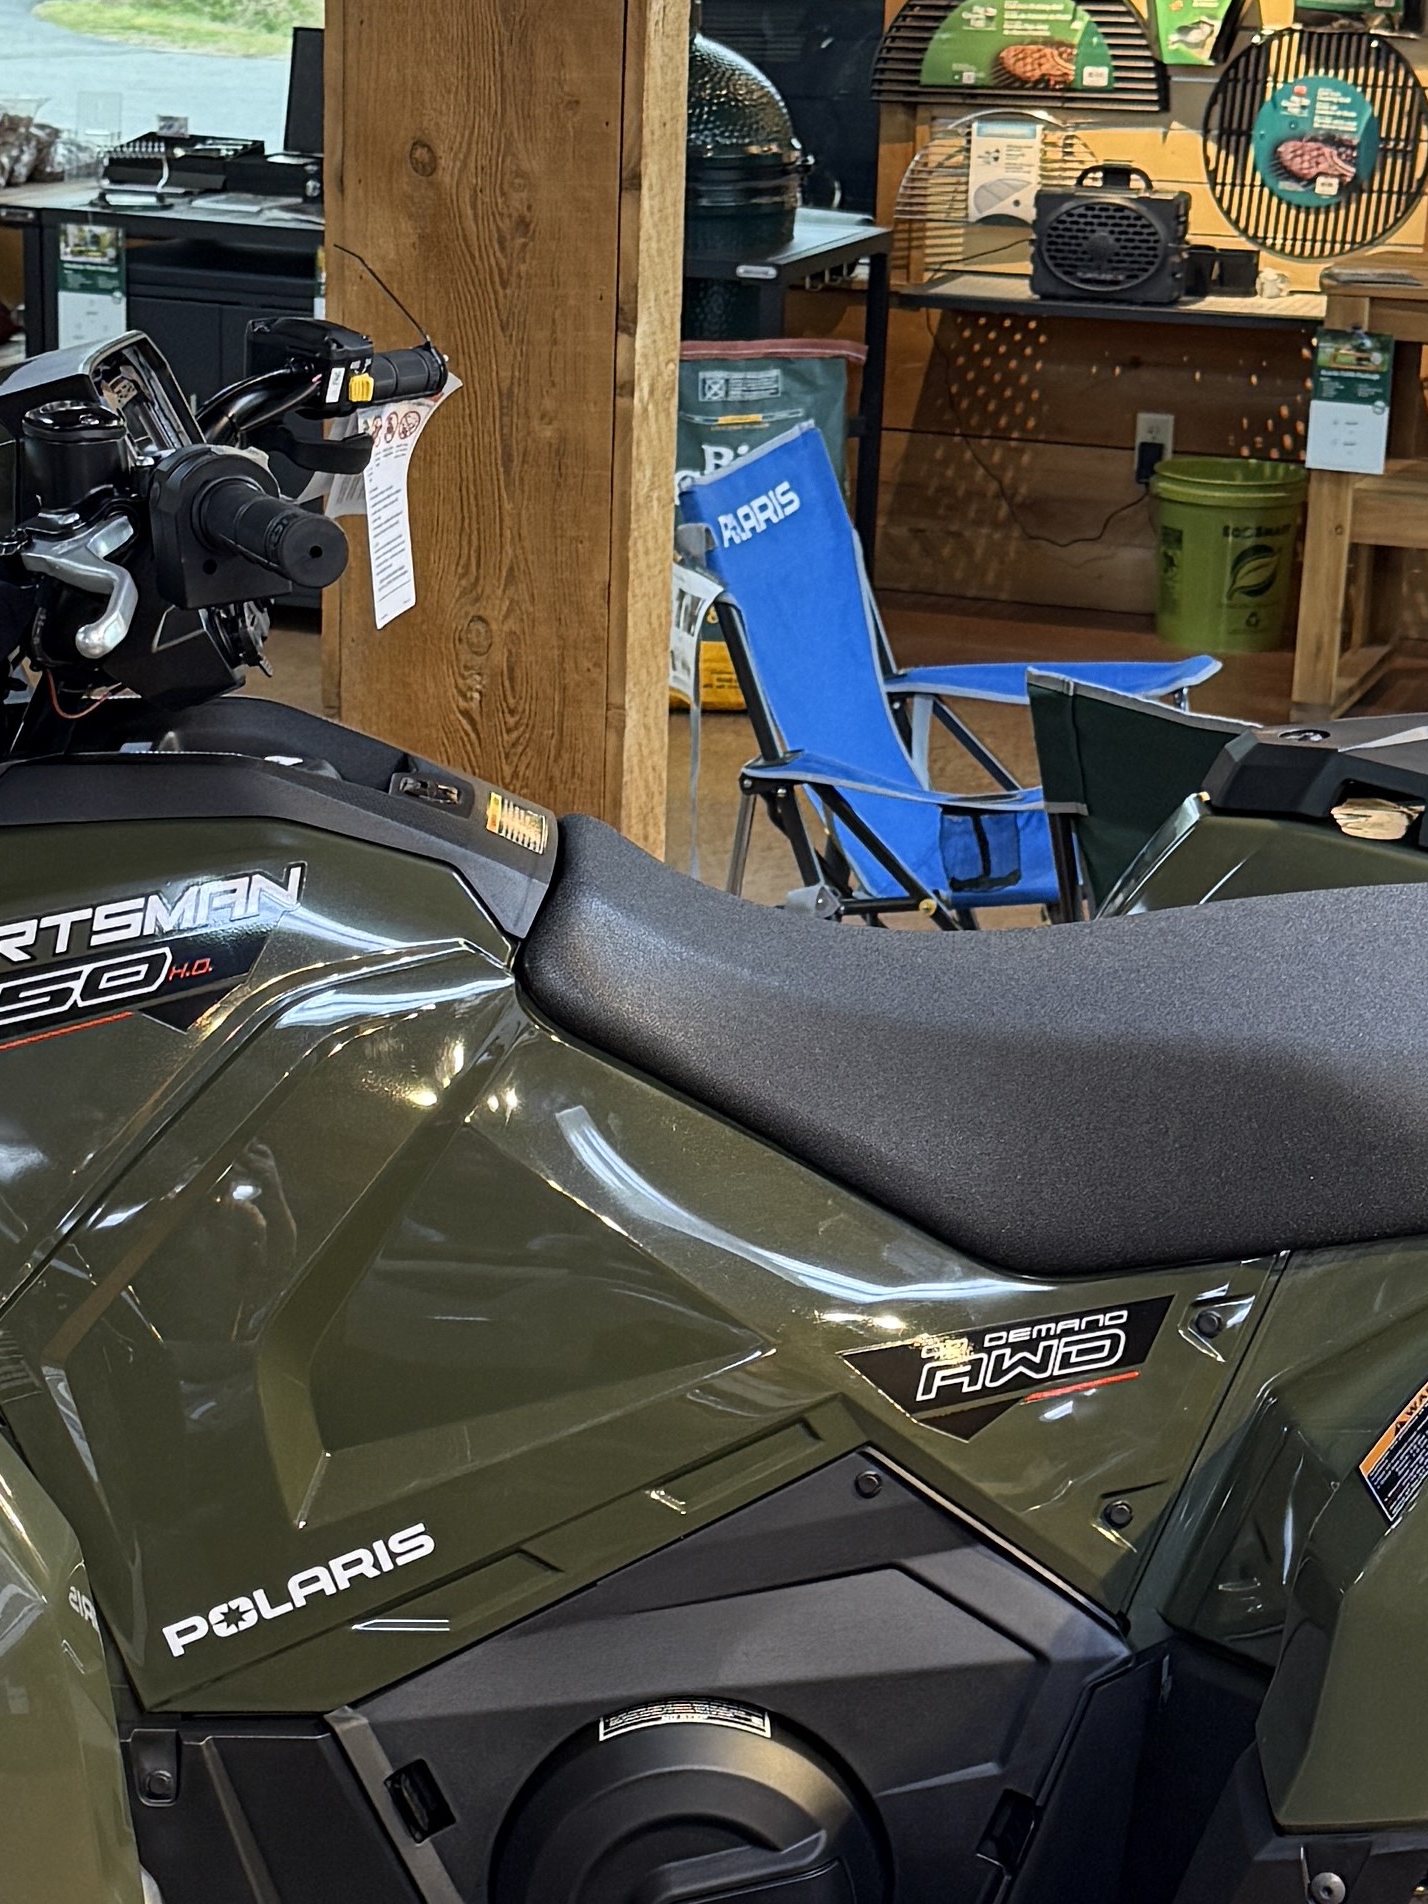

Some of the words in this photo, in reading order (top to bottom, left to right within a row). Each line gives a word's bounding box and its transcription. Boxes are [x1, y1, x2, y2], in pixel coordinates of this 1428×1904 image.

[168, 958, 215, 981] H.O.
[983, 1309, 1129, 1348] DEMAND
[915, 1327, 1127, 1402] AWD
[161, 1521, 436, 1658] POLARIS
